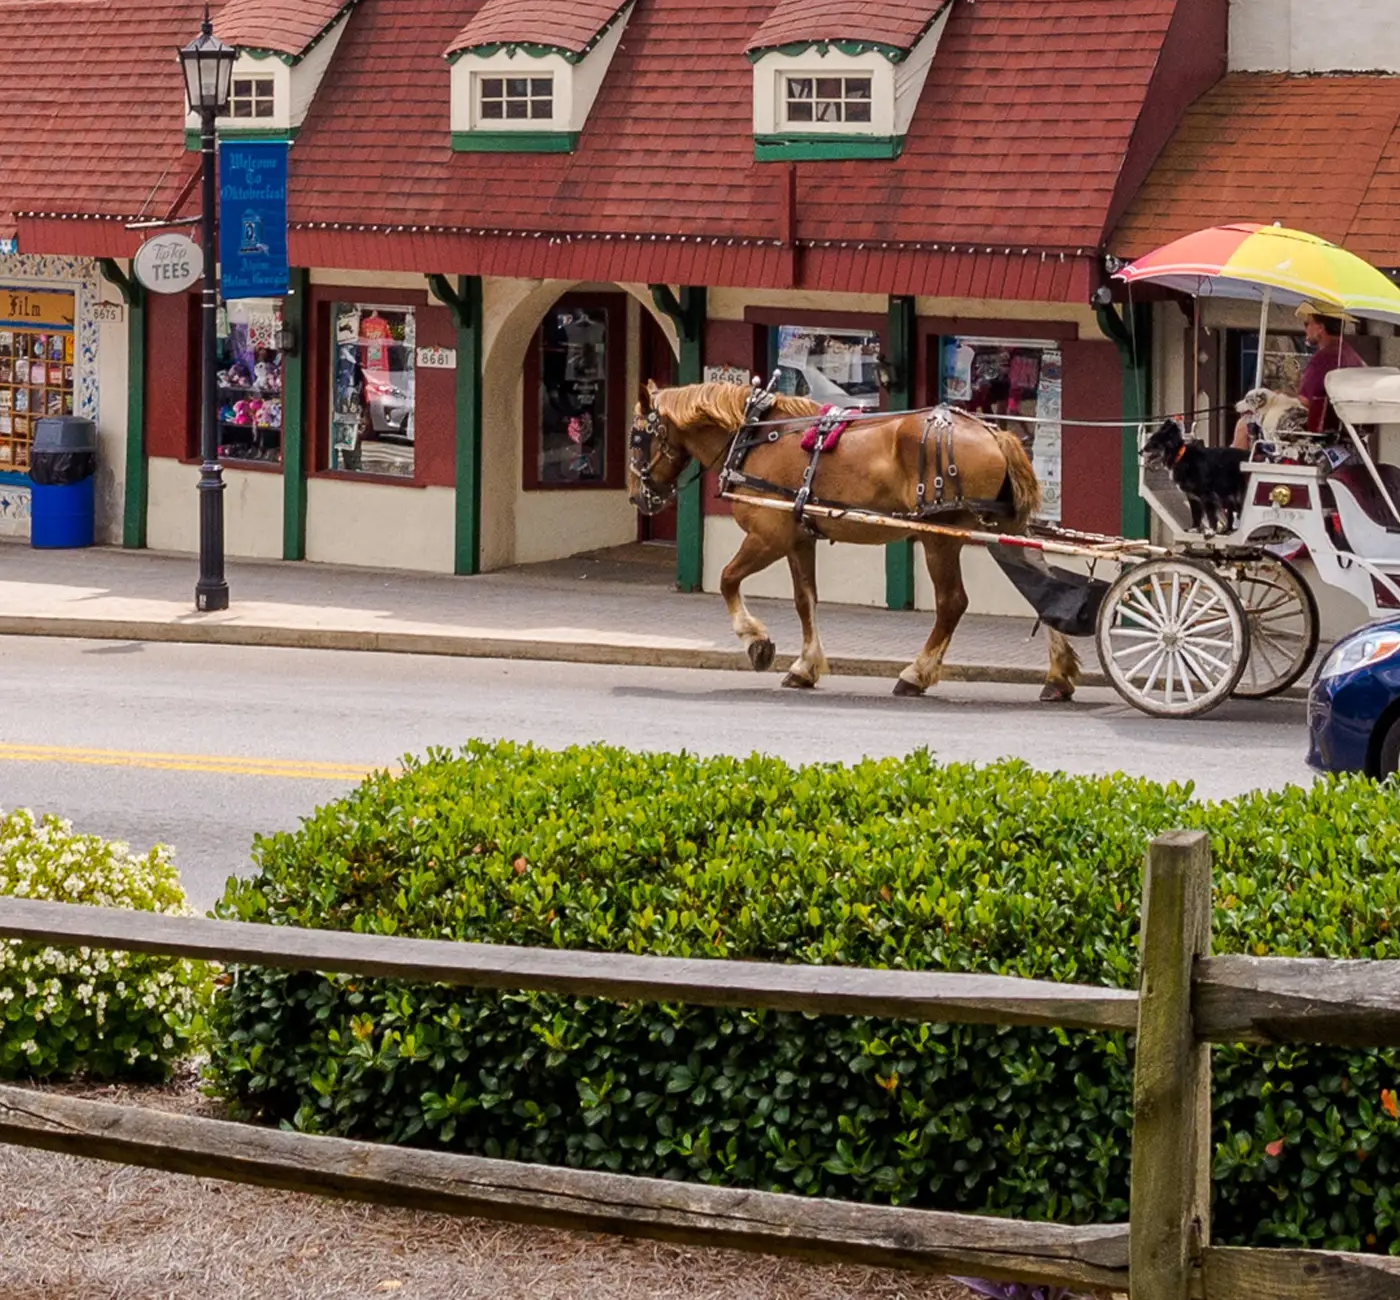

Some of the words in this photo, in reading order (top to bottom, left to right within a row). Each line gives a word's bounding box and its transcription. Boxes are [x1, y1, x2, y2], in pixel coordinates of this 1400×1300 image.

[229, 153, 277, 172] Welcome
[246, 171, 262, 185] To
[220, 184, 285, 200] Oktoberfest
[152, 243, 169, 262] Tip
[168, 242, 187, 261] Top
[152, 262, 190, 281] TEES
[8, 294, 41, 317] Film
